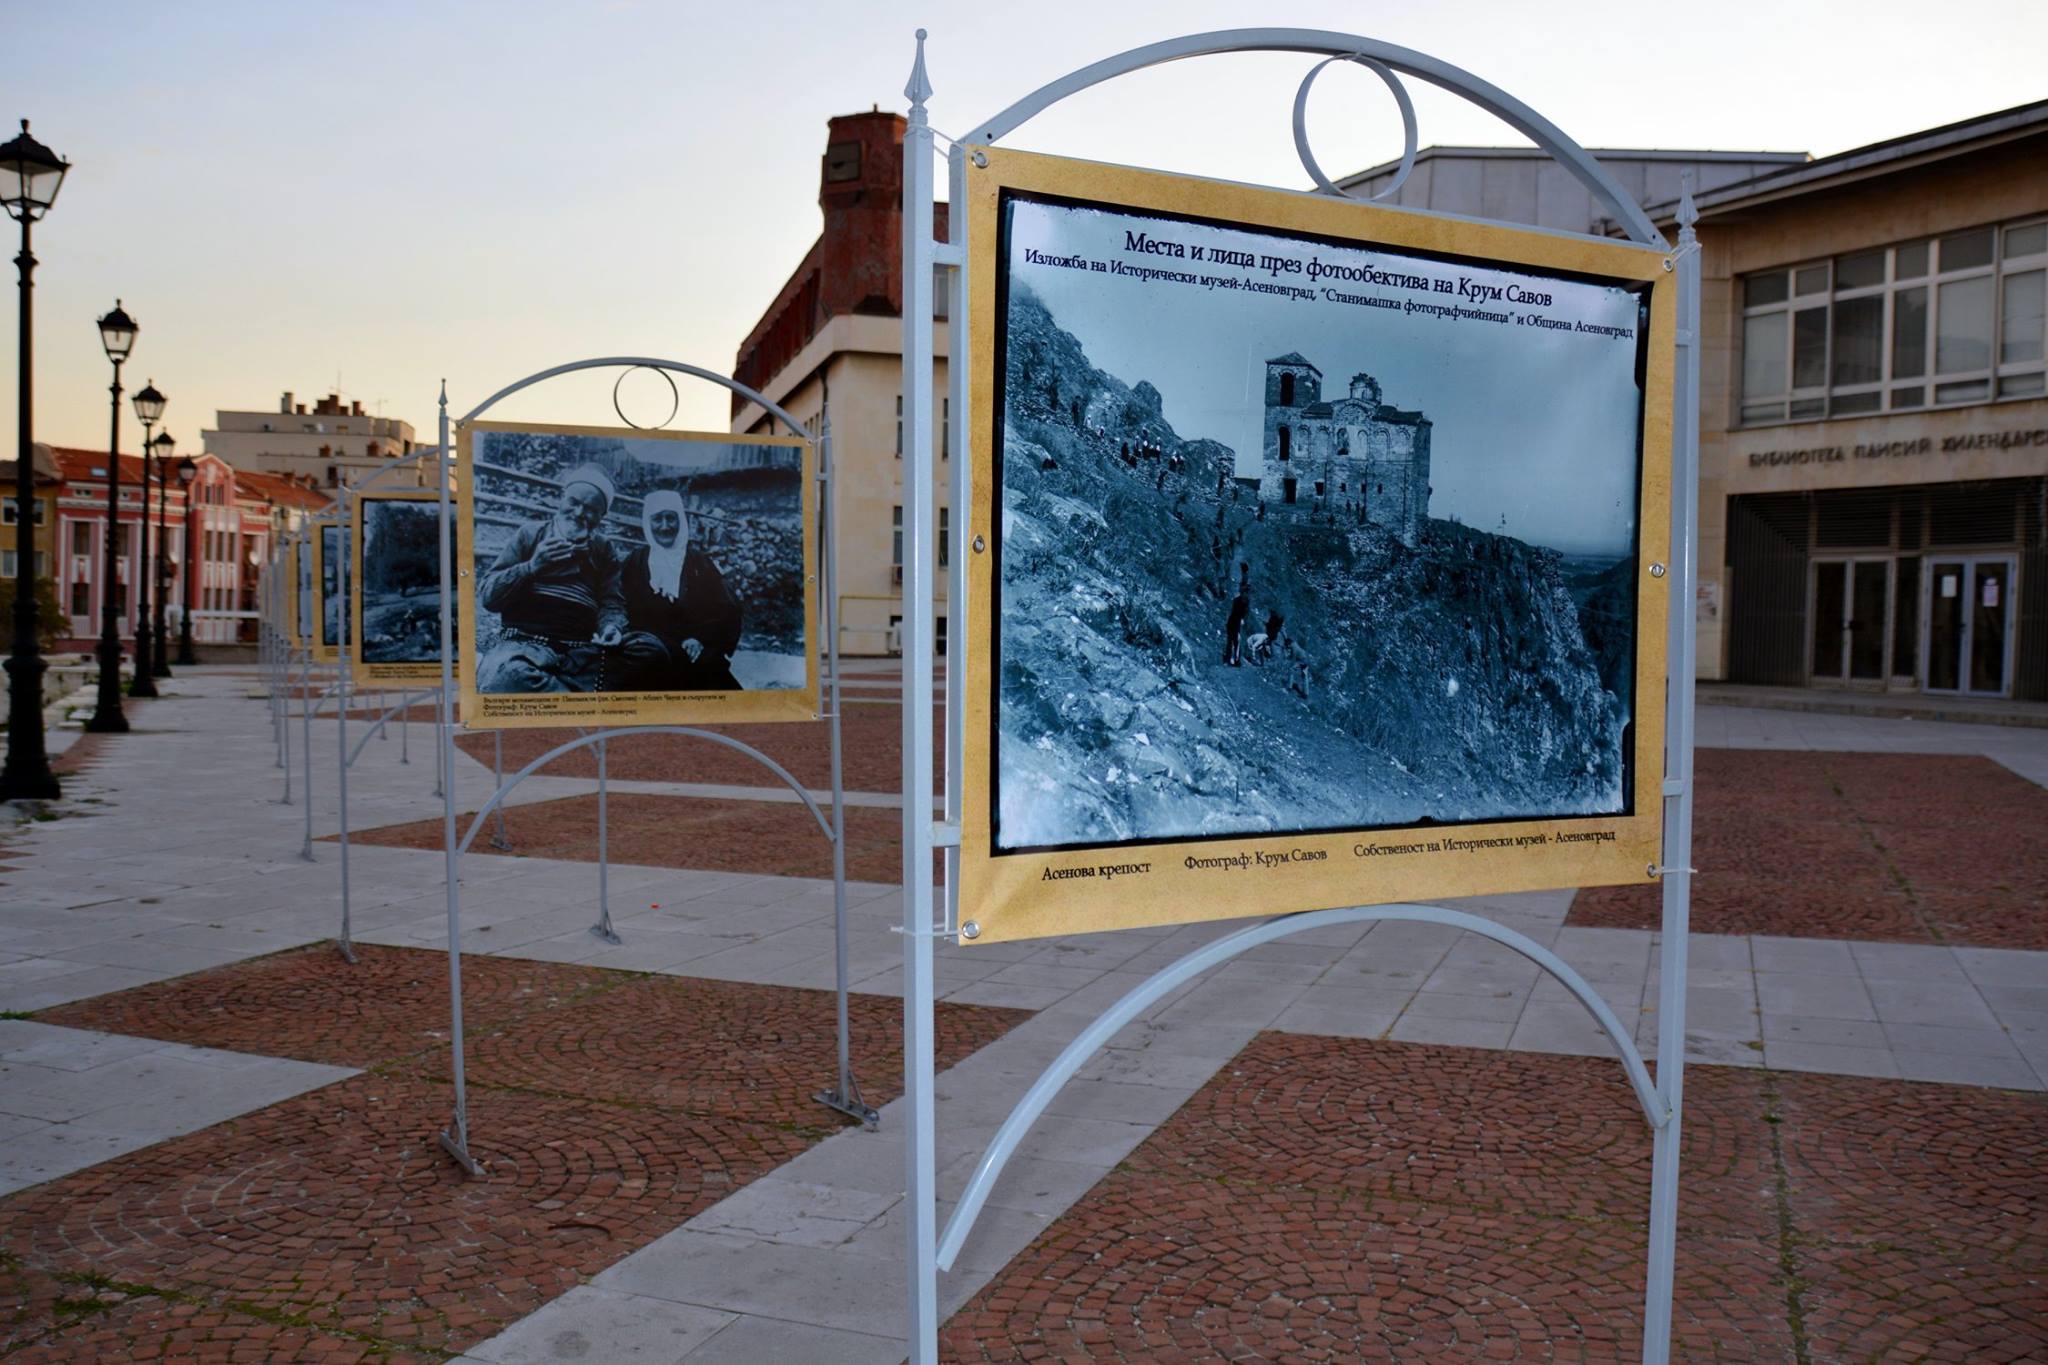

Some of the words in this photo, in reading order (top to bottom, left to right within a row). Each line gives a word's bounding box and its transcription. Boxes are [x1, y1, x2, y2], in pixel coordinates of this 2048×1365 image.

[1024, 248, 1087, 270] Изложба
[1091, 262, 1106, 273] на
[1110, 261, 1197, 284] Исторически
[1200, 274, 1317, 301] музей-Асеновград,
[1517, 314, 1524, 325] и
[1526, 314, 1572, 331] Община
[1575, 319, 1633, 340] Асеновград
[1124, 230, 1185, 258] Места
[1191, 246, 1202, 260] и
[1208, 248, 1255, 269] лица
[1261, 255, 1302, 277] през
[1306, 257, 1428, 291] фотообектива
[1434, 278, 1454, 294] на
[1457, 277, 1502, 304] Крум
[1506, 284, 1553, 307] Савов
[1749, 446, 1845, 468] БИБЛИОТЕКА
[1942, 429, 2048, 453] ХИЛЕНДАРС
[1041, 866, 1095, 881] Асенова
[1099, 862, 1151, 881] крепост
[1184, 853, 1252, 871] Фотограф:
[1255, 851, 1289, 868] Крум
[1291, 848, 1328, 862] Савов
[1353, 842, 1424, 858] Собственост
[1427, 842, 1440, 852] на
[1442, 837, 1513, 853] Исторически
[1515, 833, 1546, 849] музей
[1555, 830, 1616, 844] Асеновград
